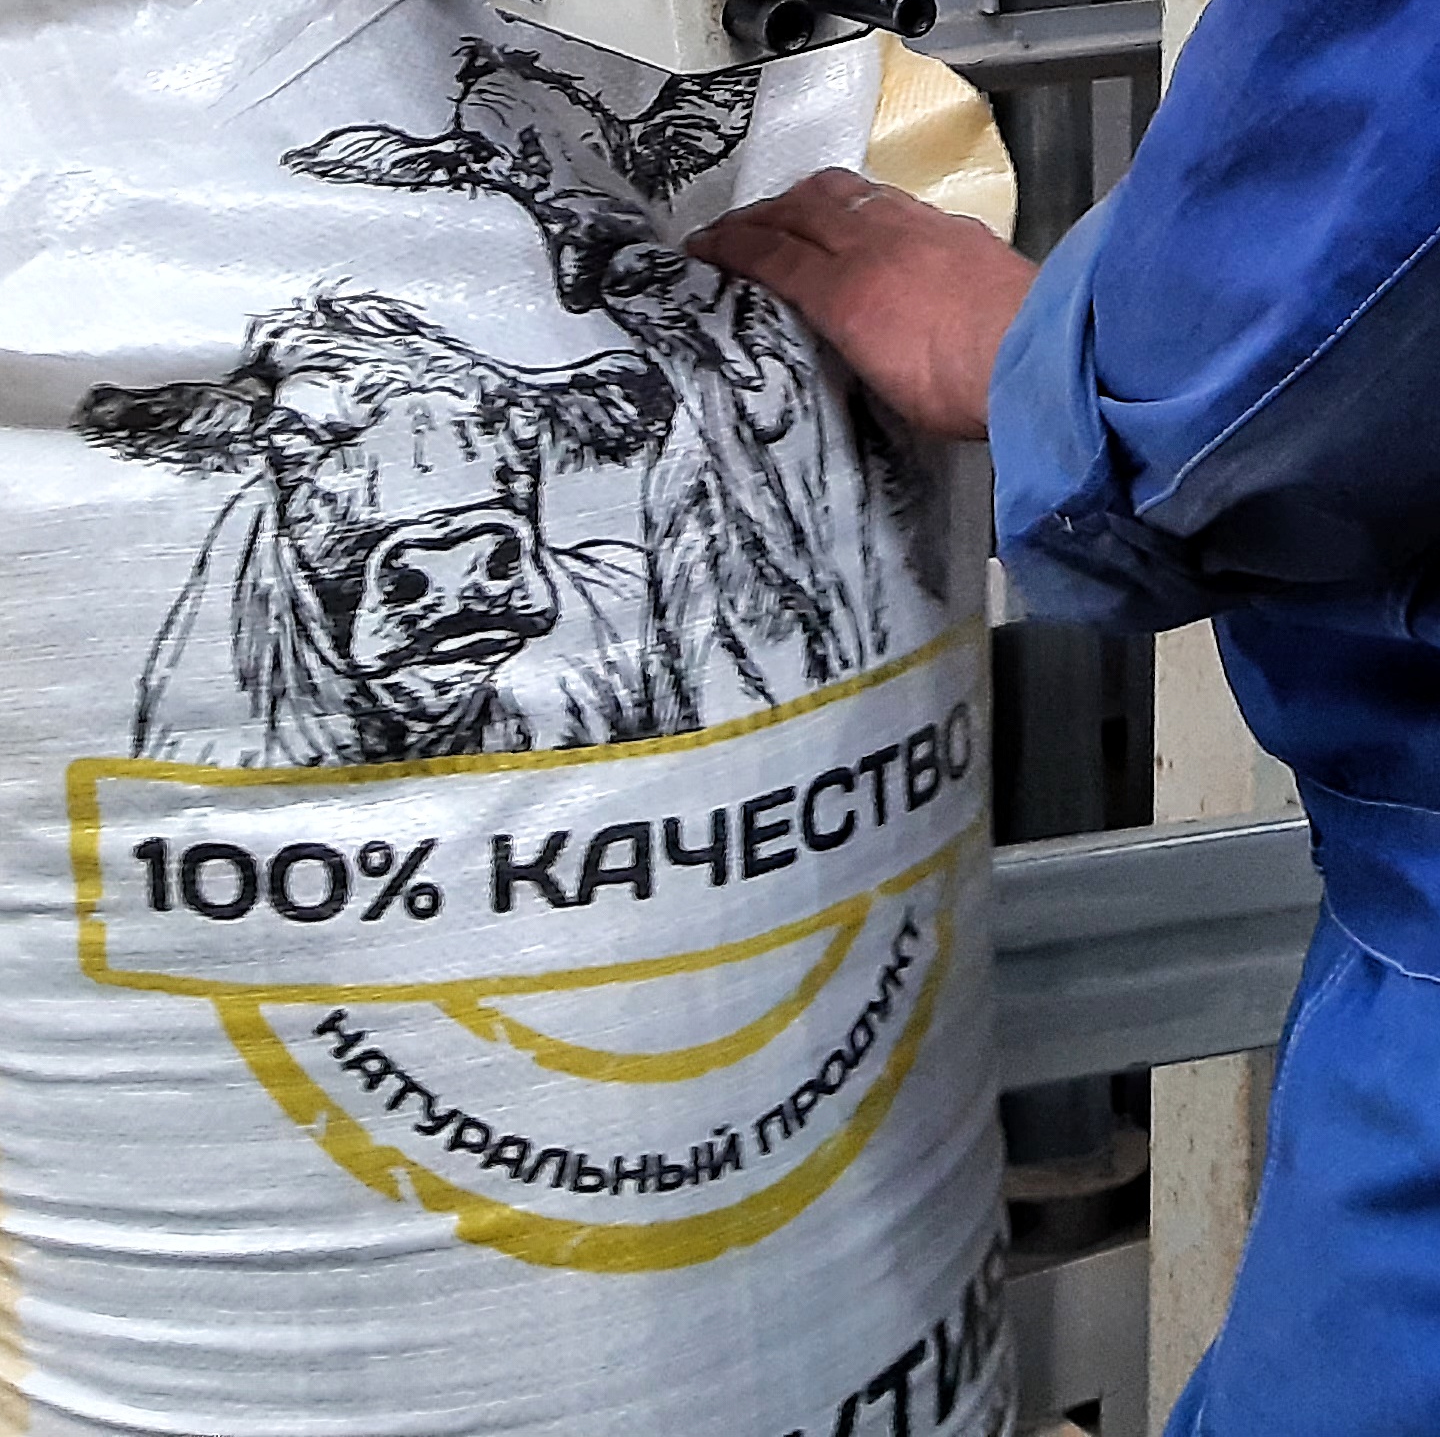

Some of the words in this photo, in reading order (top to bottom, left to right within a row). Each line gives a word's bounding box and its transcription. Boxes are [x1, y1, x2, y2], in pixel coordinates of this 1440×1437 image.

[132, 835, 442, 923] 100%
[490, 701, 972, 915] КАЧЕСТВО
[313, 1009, 743, 1196] НАТУРАЛЬНЫЙ
